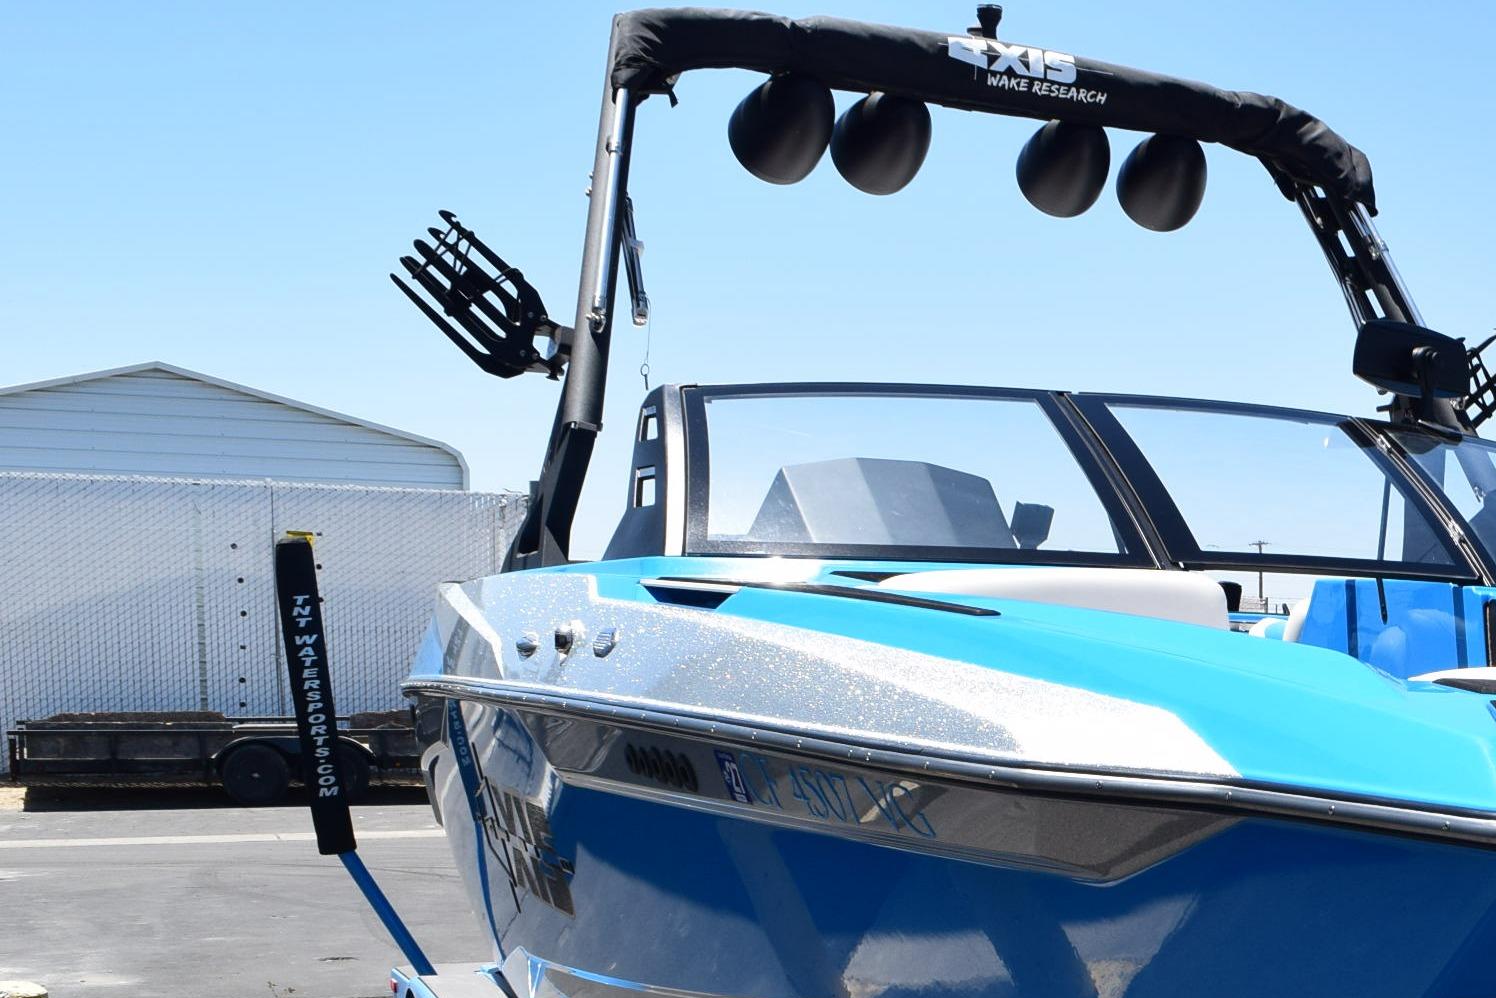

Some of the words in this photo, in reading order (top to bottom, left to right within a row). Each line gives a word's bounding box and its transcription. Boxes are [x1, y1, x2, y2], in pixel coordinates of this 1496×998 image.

[987, 72, 1029, 92] WAKE
[1031, 81, 1107, 105] RESEARCH
[293, 595, 313, 627] TNT
[295, 634, 339, 797] WATERSPORTS.COM
[739, 751, 783, 810] CF
